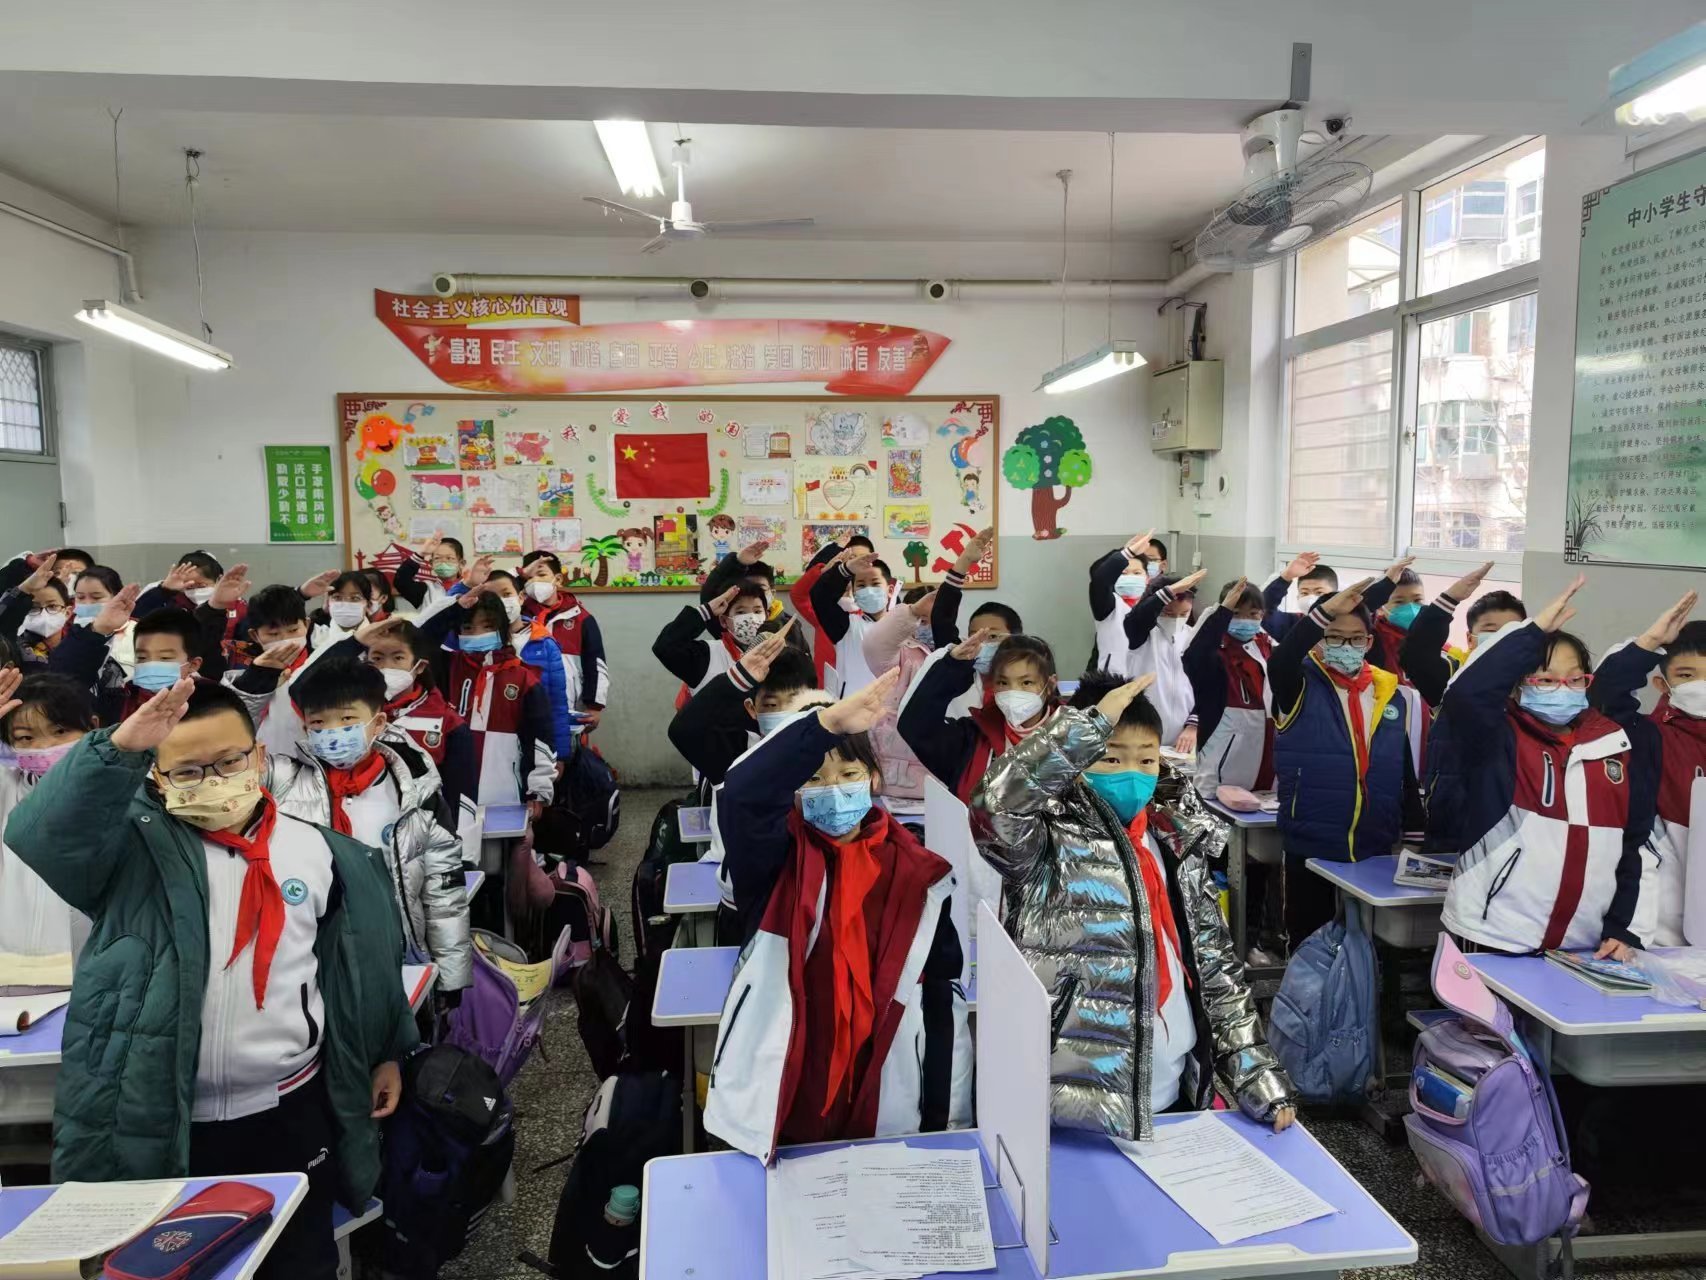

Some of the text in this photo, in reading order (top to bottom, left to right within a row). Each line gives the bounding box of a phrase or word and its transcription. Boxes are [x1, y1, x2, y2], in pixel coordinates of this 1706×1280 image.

[392, 296, 568, 319] 社会主义核心价值观
[450, 338, 906, 371] 富强 民主 文明 和谐 自由 平等 公正 法治 爱国 敬业 诚信 友善
